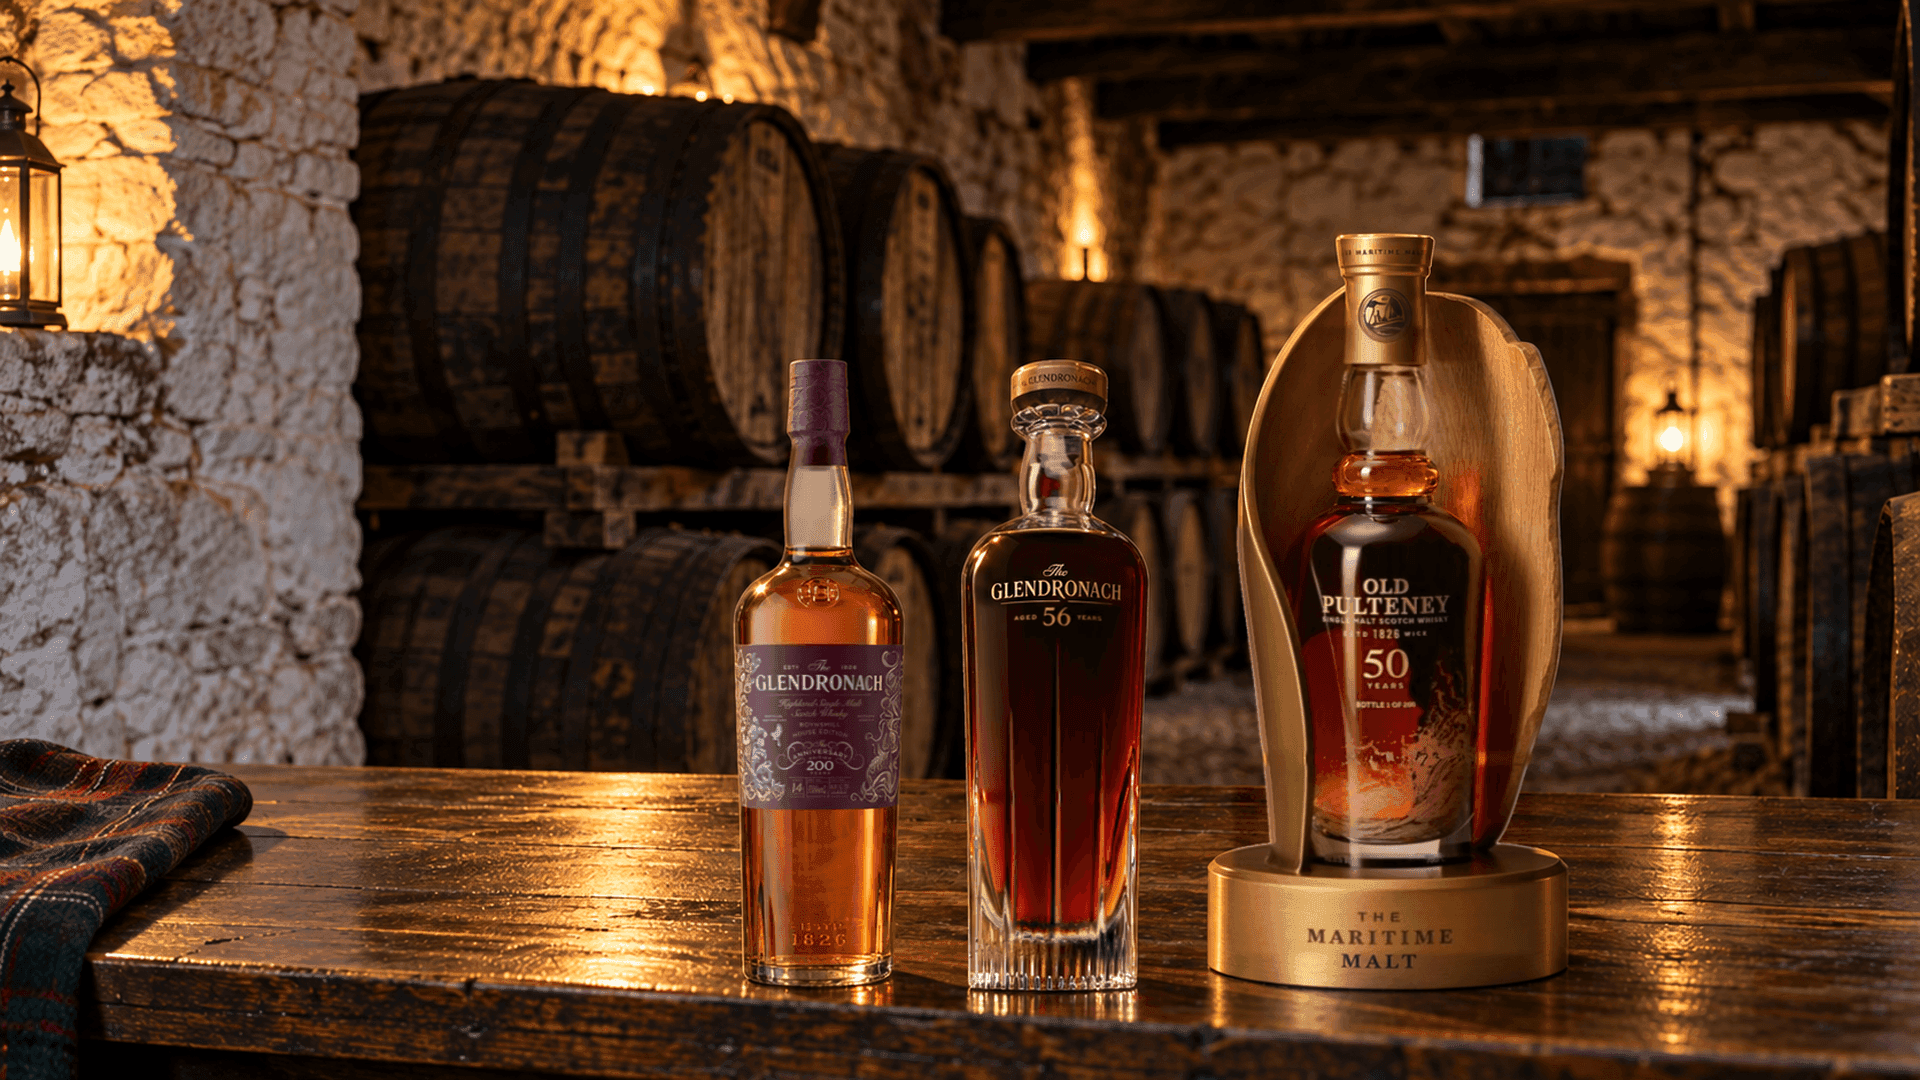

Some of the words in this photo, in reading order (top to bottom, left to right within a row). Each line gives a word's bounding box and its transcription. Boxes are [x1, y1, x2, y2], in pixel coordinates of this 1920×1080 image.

[1042, 563, 1069, 577] The
[990, 579, 1121, 601] GLENDRONACH
[1362, 577, 1410, 595] OLD
[1321, 595, 1450, 615] PULTENEY
[1013, 613, 1038, 621] AGED
[1042, 606, 1072, 627] 56
[1076, 614, 1103, 622] YEARS
[1353, 617, 1377, 625] MALT
[1379, 617, 1415, 625] SCOTCH
[1372, 628, 1401, 640] 1826
[1362, 648, 1410, 679] 50
[755, 673, 883, 693] GLENDRONACH
[1366, 682, 1404, 690] YEARS
[806, 760, 835, 771] 200
[791, 782, 803, 794] 14
[1357, 911, 1401, 923] THE
[792, 933, 846, 947] 1826
[1307, 928, 1454, 946] MARITIME
[1341, 953, 1417, 970] MALT
